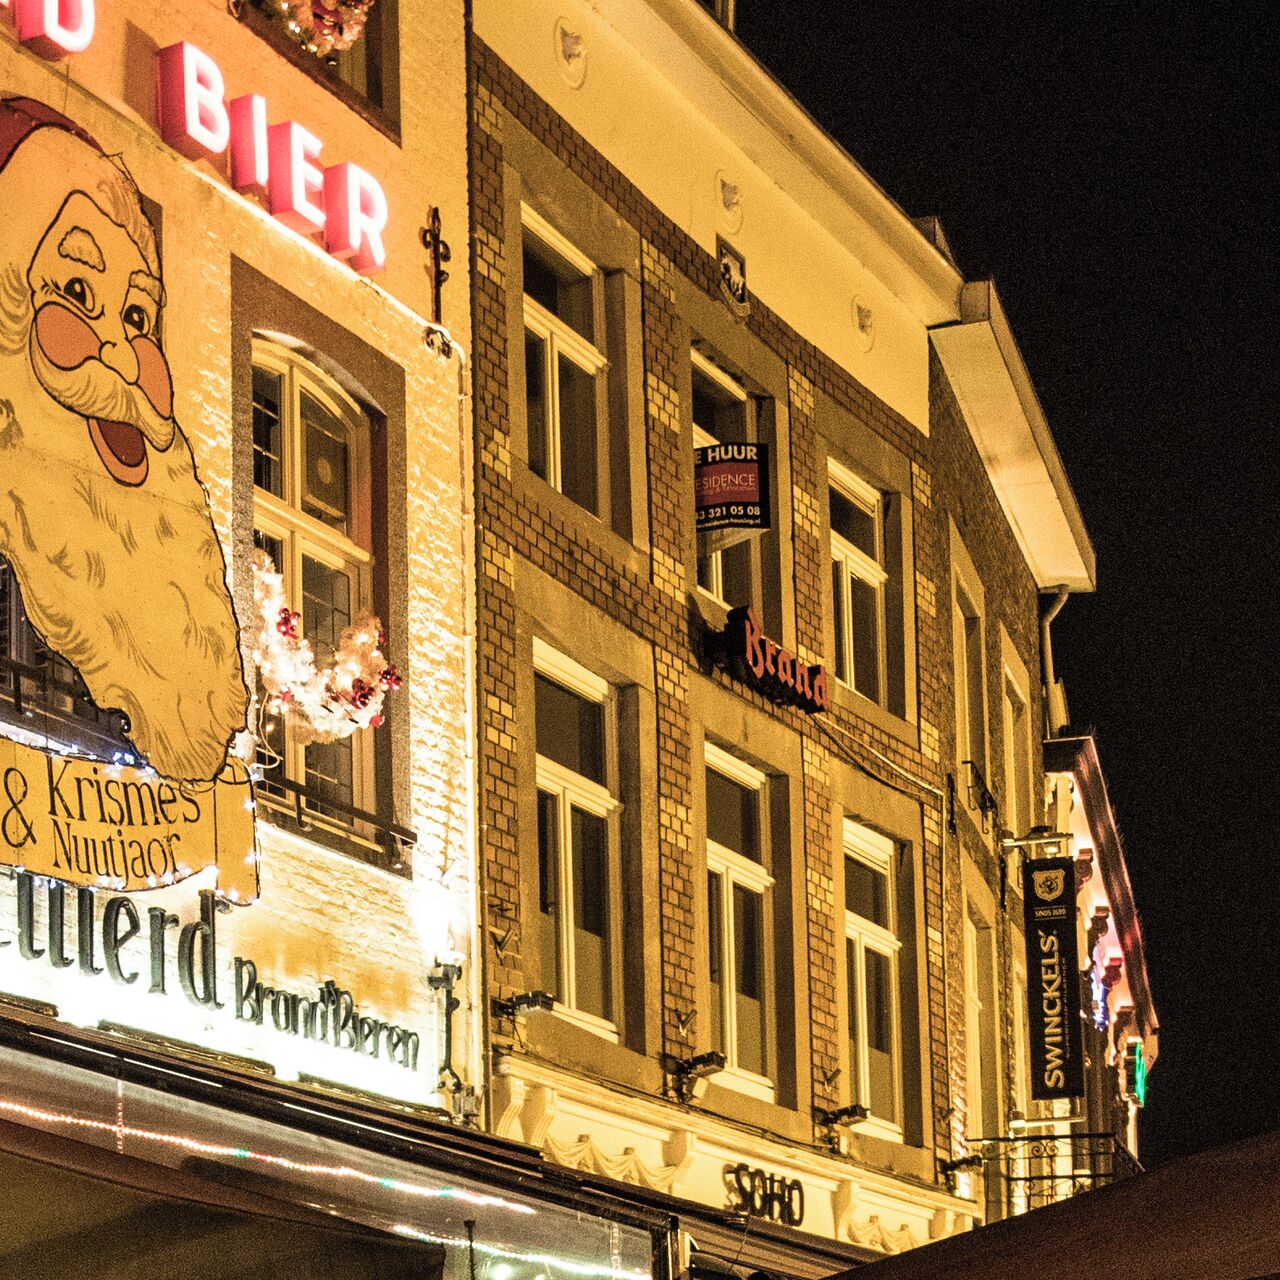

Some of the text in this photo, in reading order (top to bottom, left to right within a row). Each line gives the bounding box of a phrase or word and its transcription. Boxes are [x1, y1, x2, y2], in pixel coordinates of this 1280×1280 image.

[161, 40, 389, 272] BIER
[696, 473, 756, 491] ESIDENCE
[707, 445, 758, 462] HUUR
[709, 506, 726, 518] 321
[730, 505, 744, 515] 05
[747, 506, 760, 516] 08
[745, 606, 829, 710] Brand
[1, 767, 37, 849] &
[45, 754, 201, 827] Krismes
[50, 817, 181, 889] Nuutjaor
[332, 986, 420, 1072] Bieren
[733, 1162, 805, 1227] SOHO
